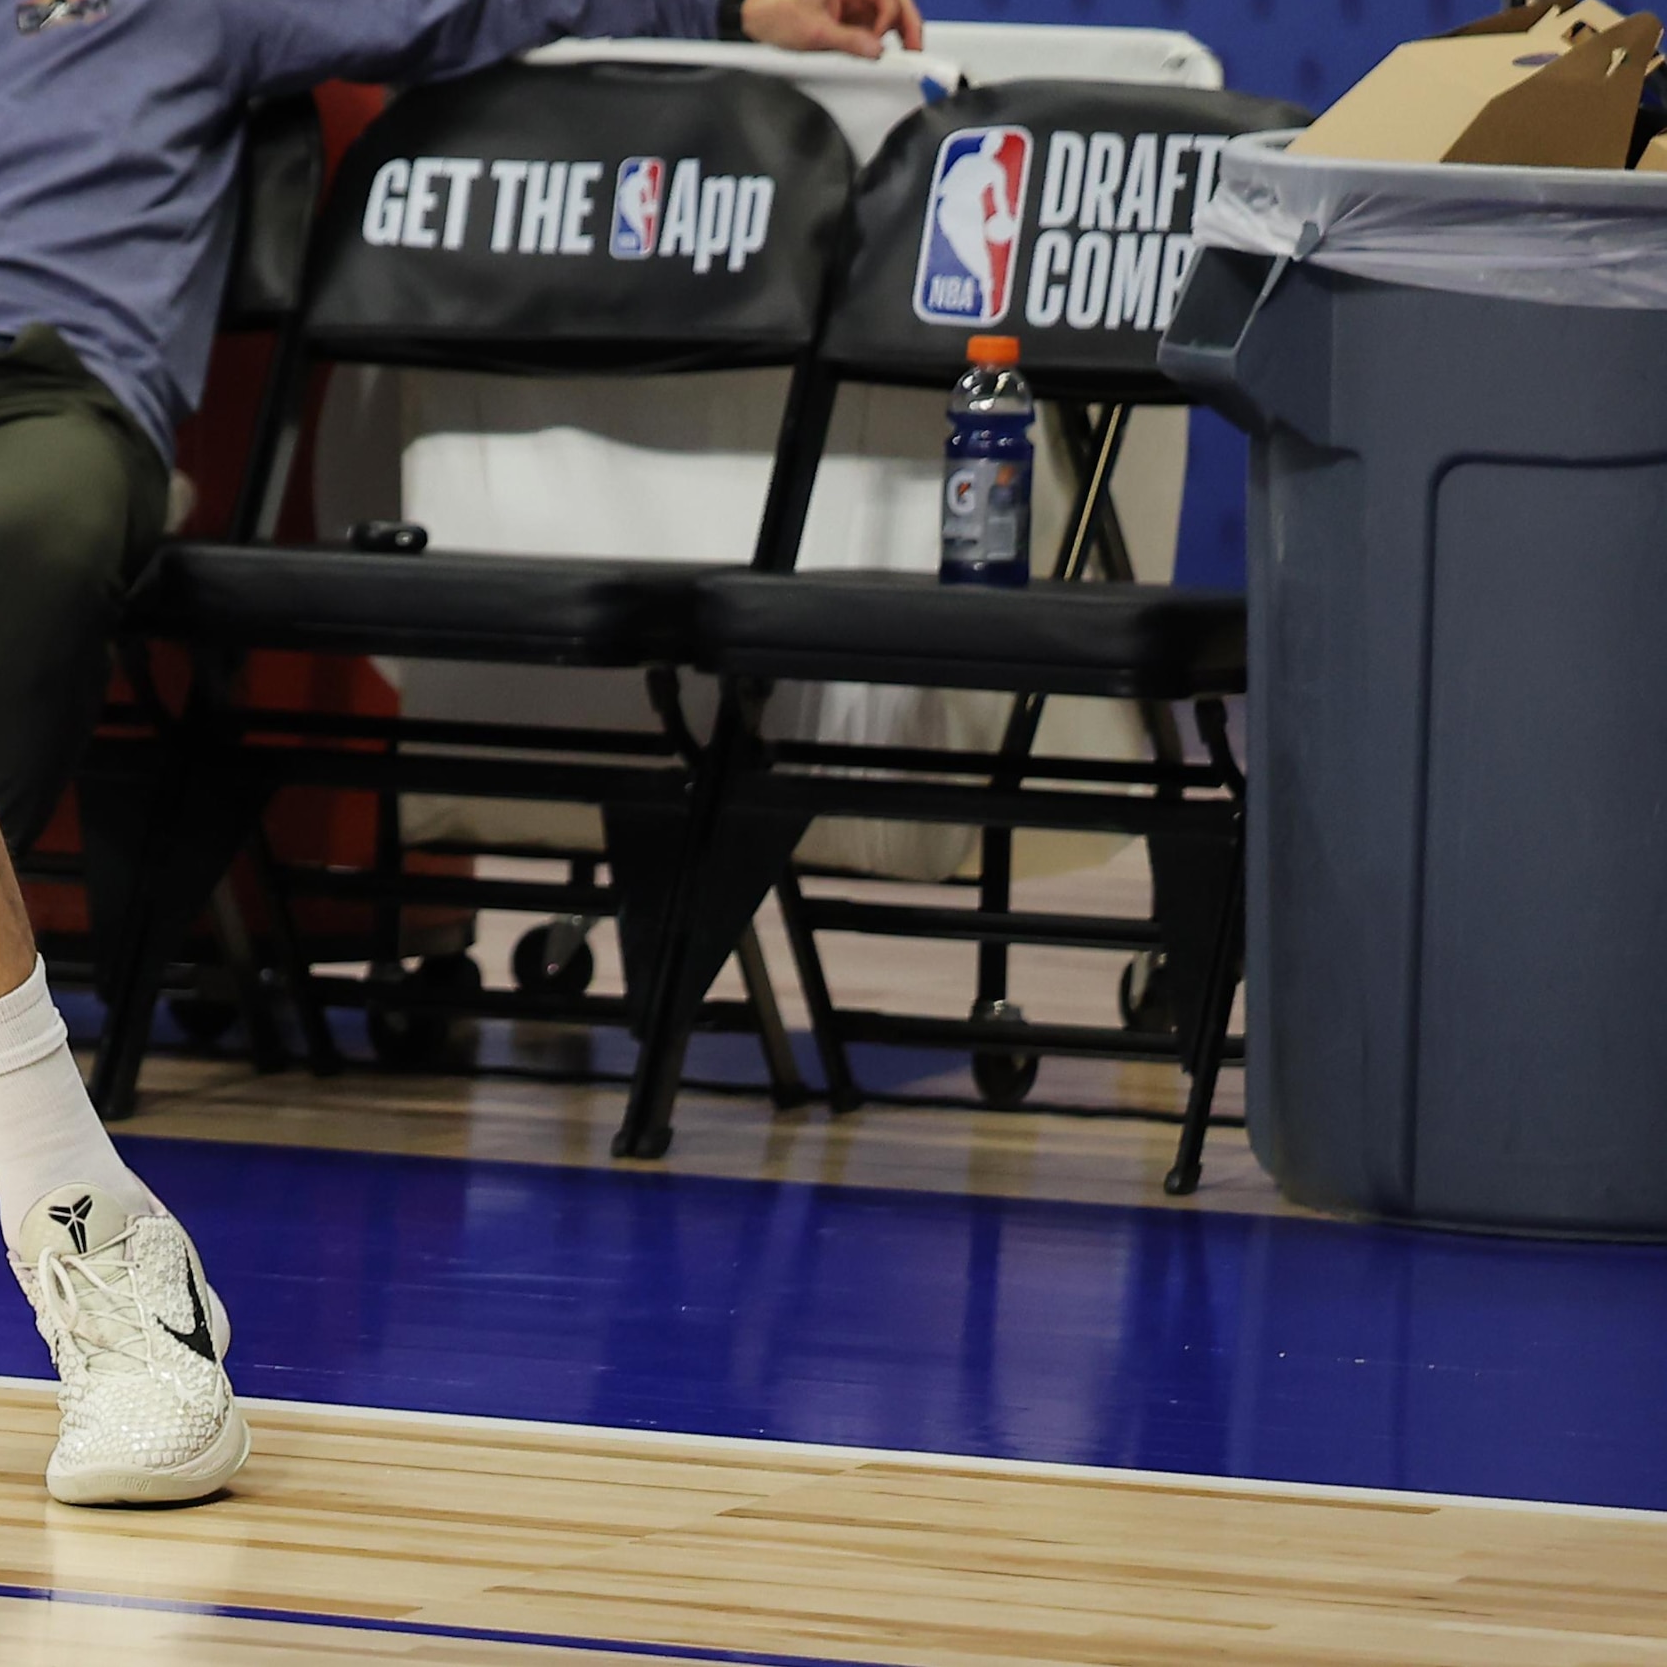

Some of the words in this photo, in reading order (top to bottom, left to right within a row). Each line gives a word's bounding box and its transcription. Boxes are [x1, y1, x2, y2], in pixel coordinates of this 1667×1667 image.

[361, 156, 483, 251] GET
[489, 158, 604, 255] THE
[657, 157, 776, 274] App
[1038, 130, 1231, 232] DRAFT
[927, 275, 977, 311] NBA
